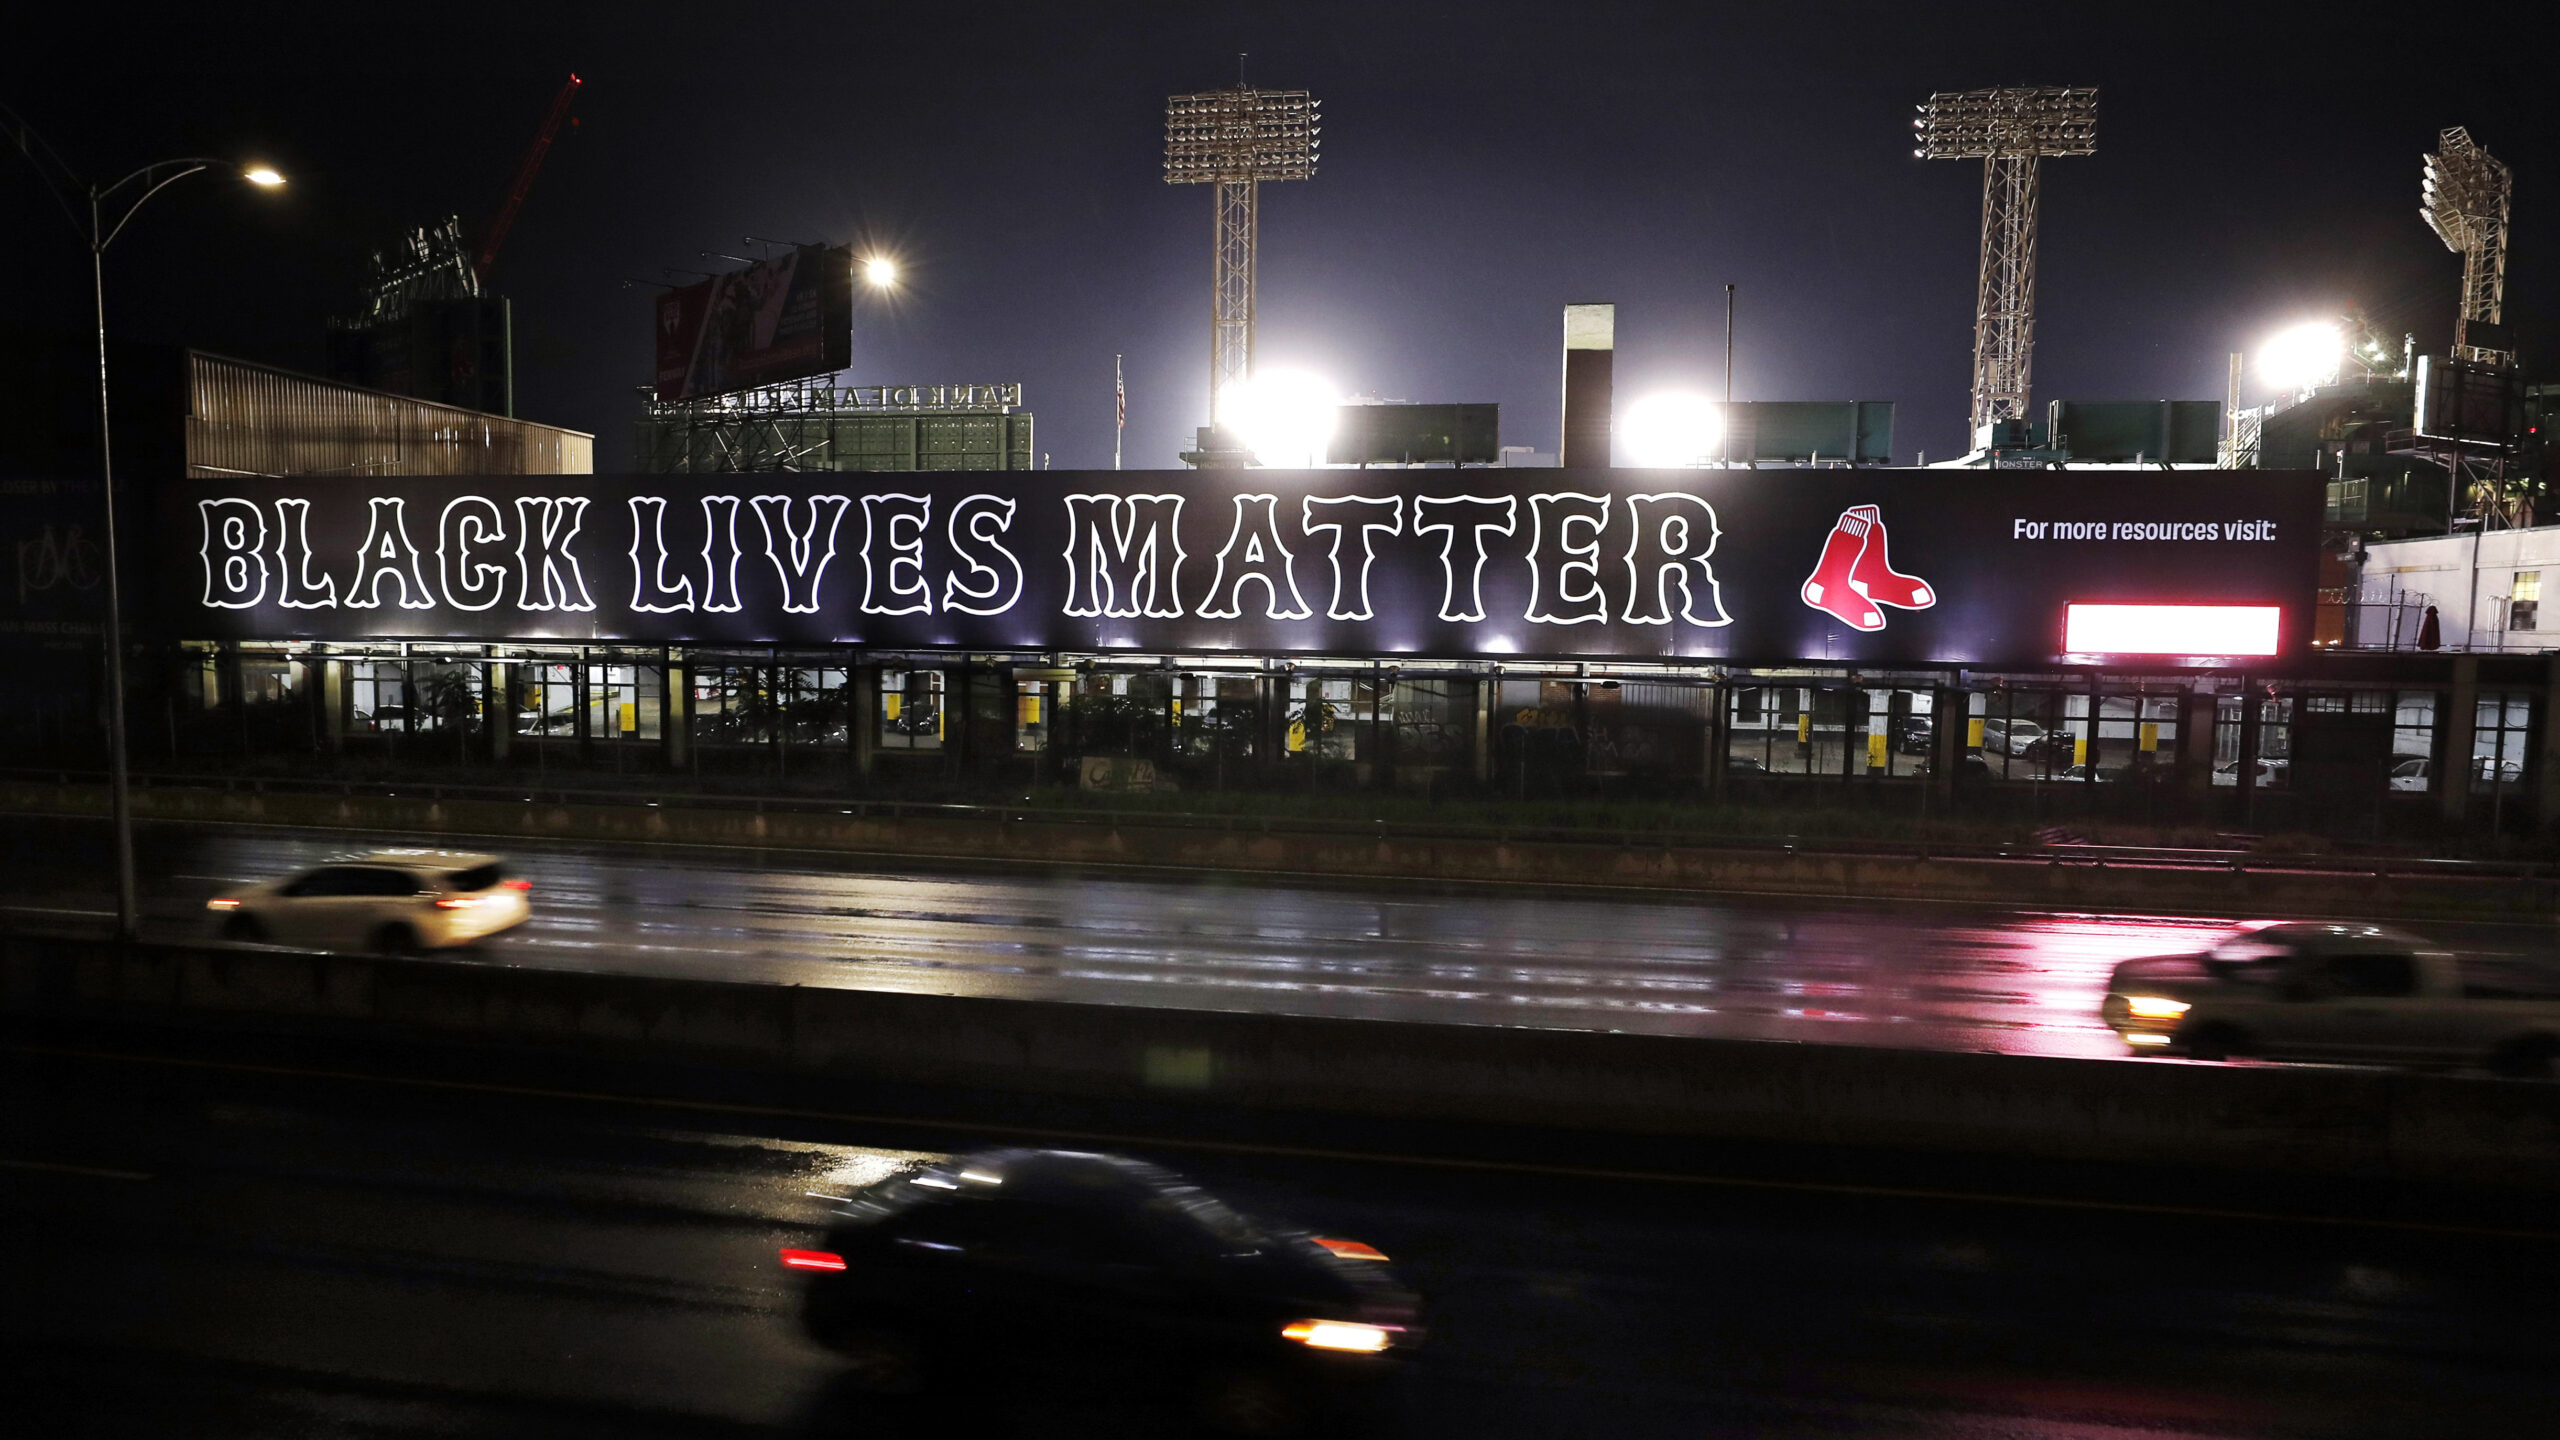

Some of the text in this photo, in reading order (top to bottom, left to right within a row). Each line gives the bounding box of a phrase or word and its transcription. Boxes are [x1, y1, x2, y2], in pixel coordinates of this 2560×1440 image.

[197, 492, 1734, 627] BLACK LIVES MATTER
[2014, 519, 2277, 541] For more resources visit:
